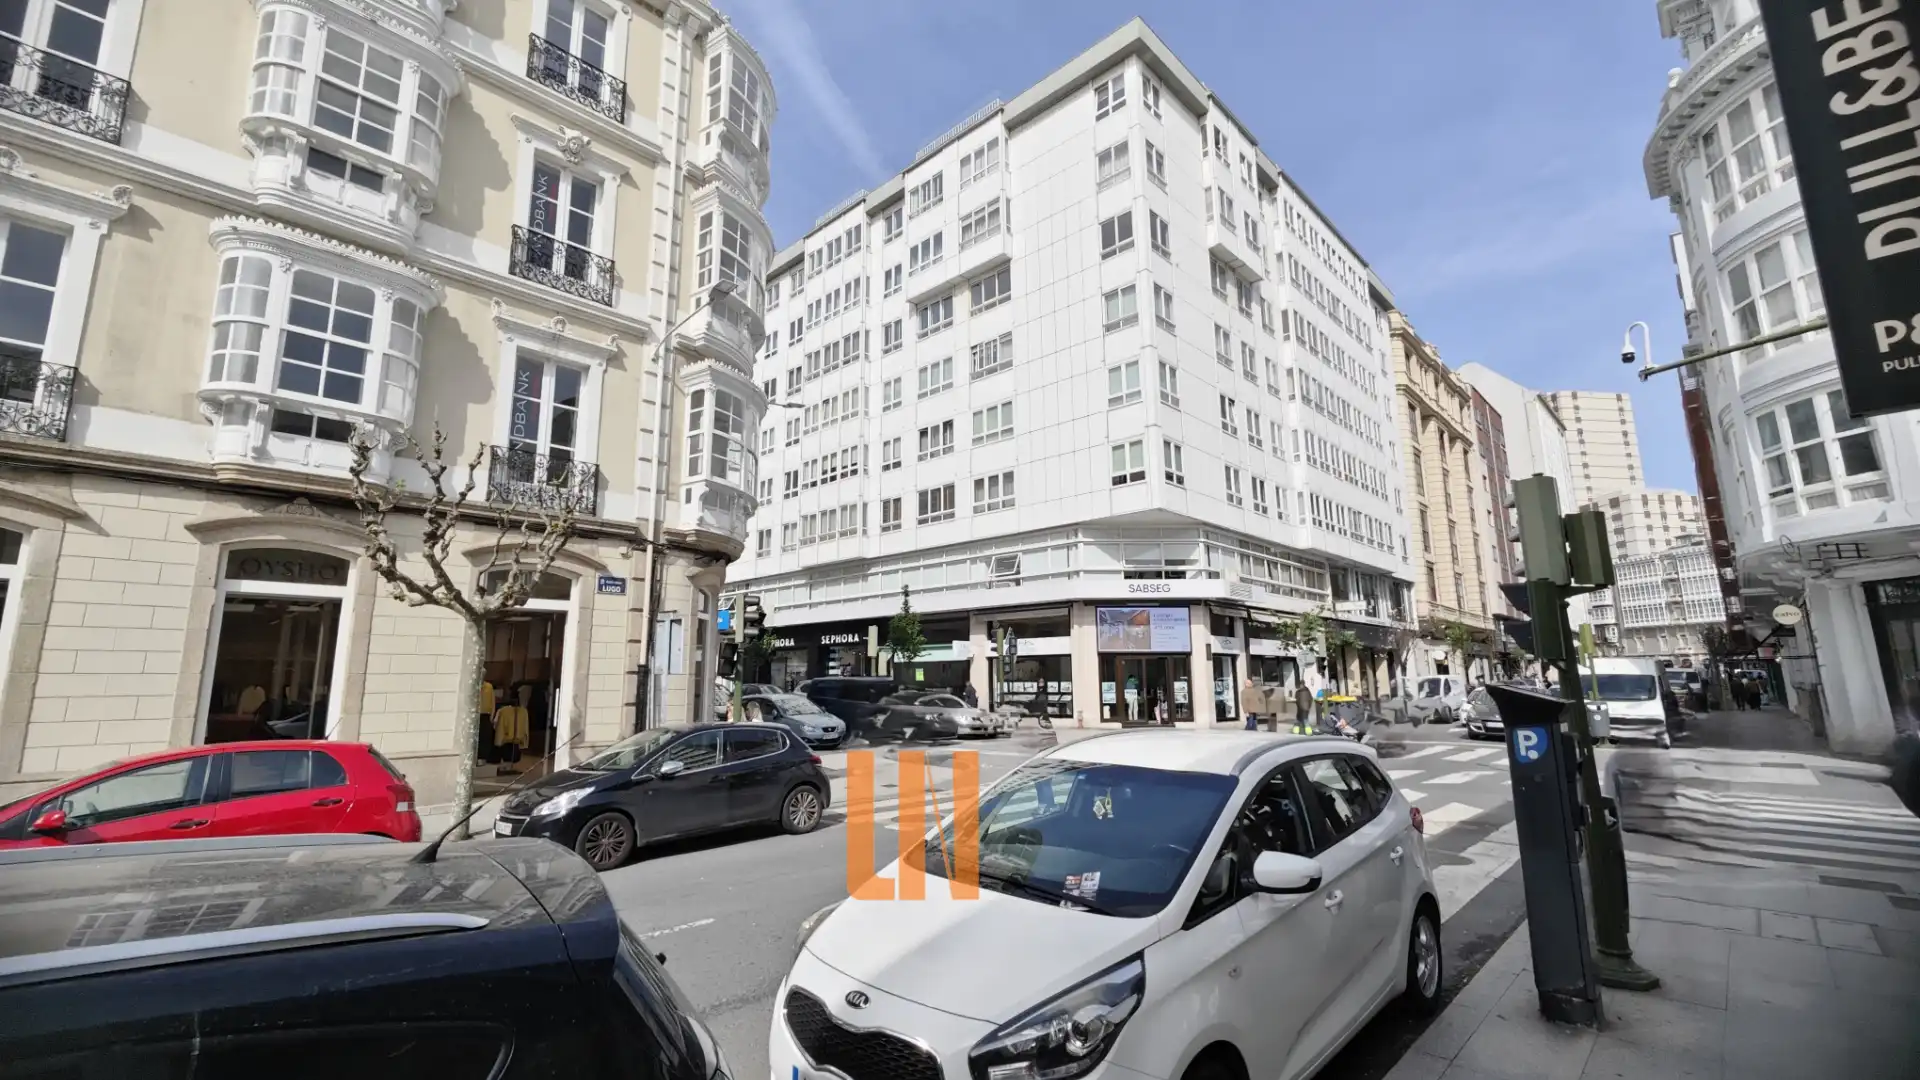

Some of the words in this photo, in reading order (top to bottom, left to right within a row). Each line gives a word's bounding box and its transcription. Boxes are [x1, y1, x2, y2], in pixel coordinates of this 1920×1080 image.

[1882, 355, 1920, 373] PUL
[602, 585, 621, 593] LUGO
[1128, 583, 1171, 593] SABSEG
[821, 633, 860, 645] SEPHORA
[847, 992, 866, 1006] KIA
